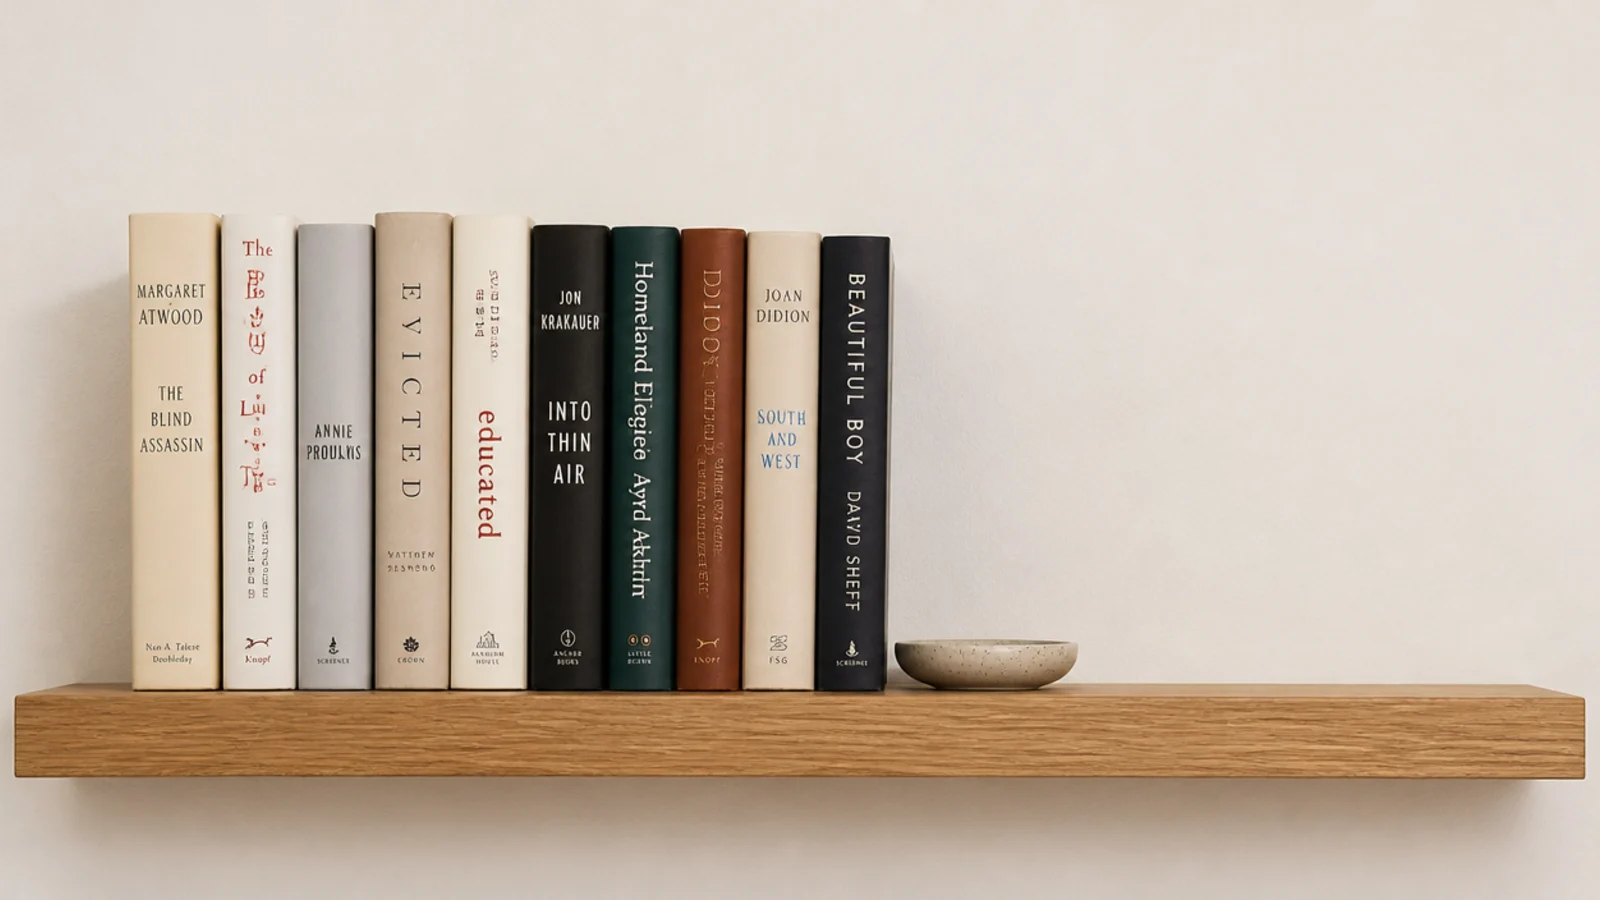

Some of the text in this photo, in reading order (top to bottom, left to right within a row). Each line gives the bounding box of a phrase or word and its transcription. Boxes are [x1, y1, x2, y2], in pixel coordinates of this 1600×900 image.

[242, 239, 273, 256] The
[137, 284, 205, 298] MARGARET
[559, 291, 581, 305] JON
[765, 289, 802, 302] JOAN
[139, 309, 203, 325] ATWOOD
[541, 314, 600, 330] KRAKAUER
[634, 261, 654, 373] Homeland
[757, 309, 810, 323] DIDION
[248, 369, 267, 384] of
[846, 274, 866, 466] BEAUTIFUL BOY
[159, 386, 183, 401] THE
[401, 282, 422, 499] EVICTED
[549, 400, 592, 421] INTO
[757, 409, 806, 425] SOUTH
[151, 411, 192, 427] BLIND
[315, 424, 352, 438] ANNIE
[140, 438, 204, 453] ASSASSIN
[548, 432, 592, 452] THIN
[767, 432, 796, 447] AND
[761, 454, 800, 469] WEST
[478, 410, 502, 539] educated
[554, 464, 585, 484] AIR
[845, 555, 860, 611] SHEFF
